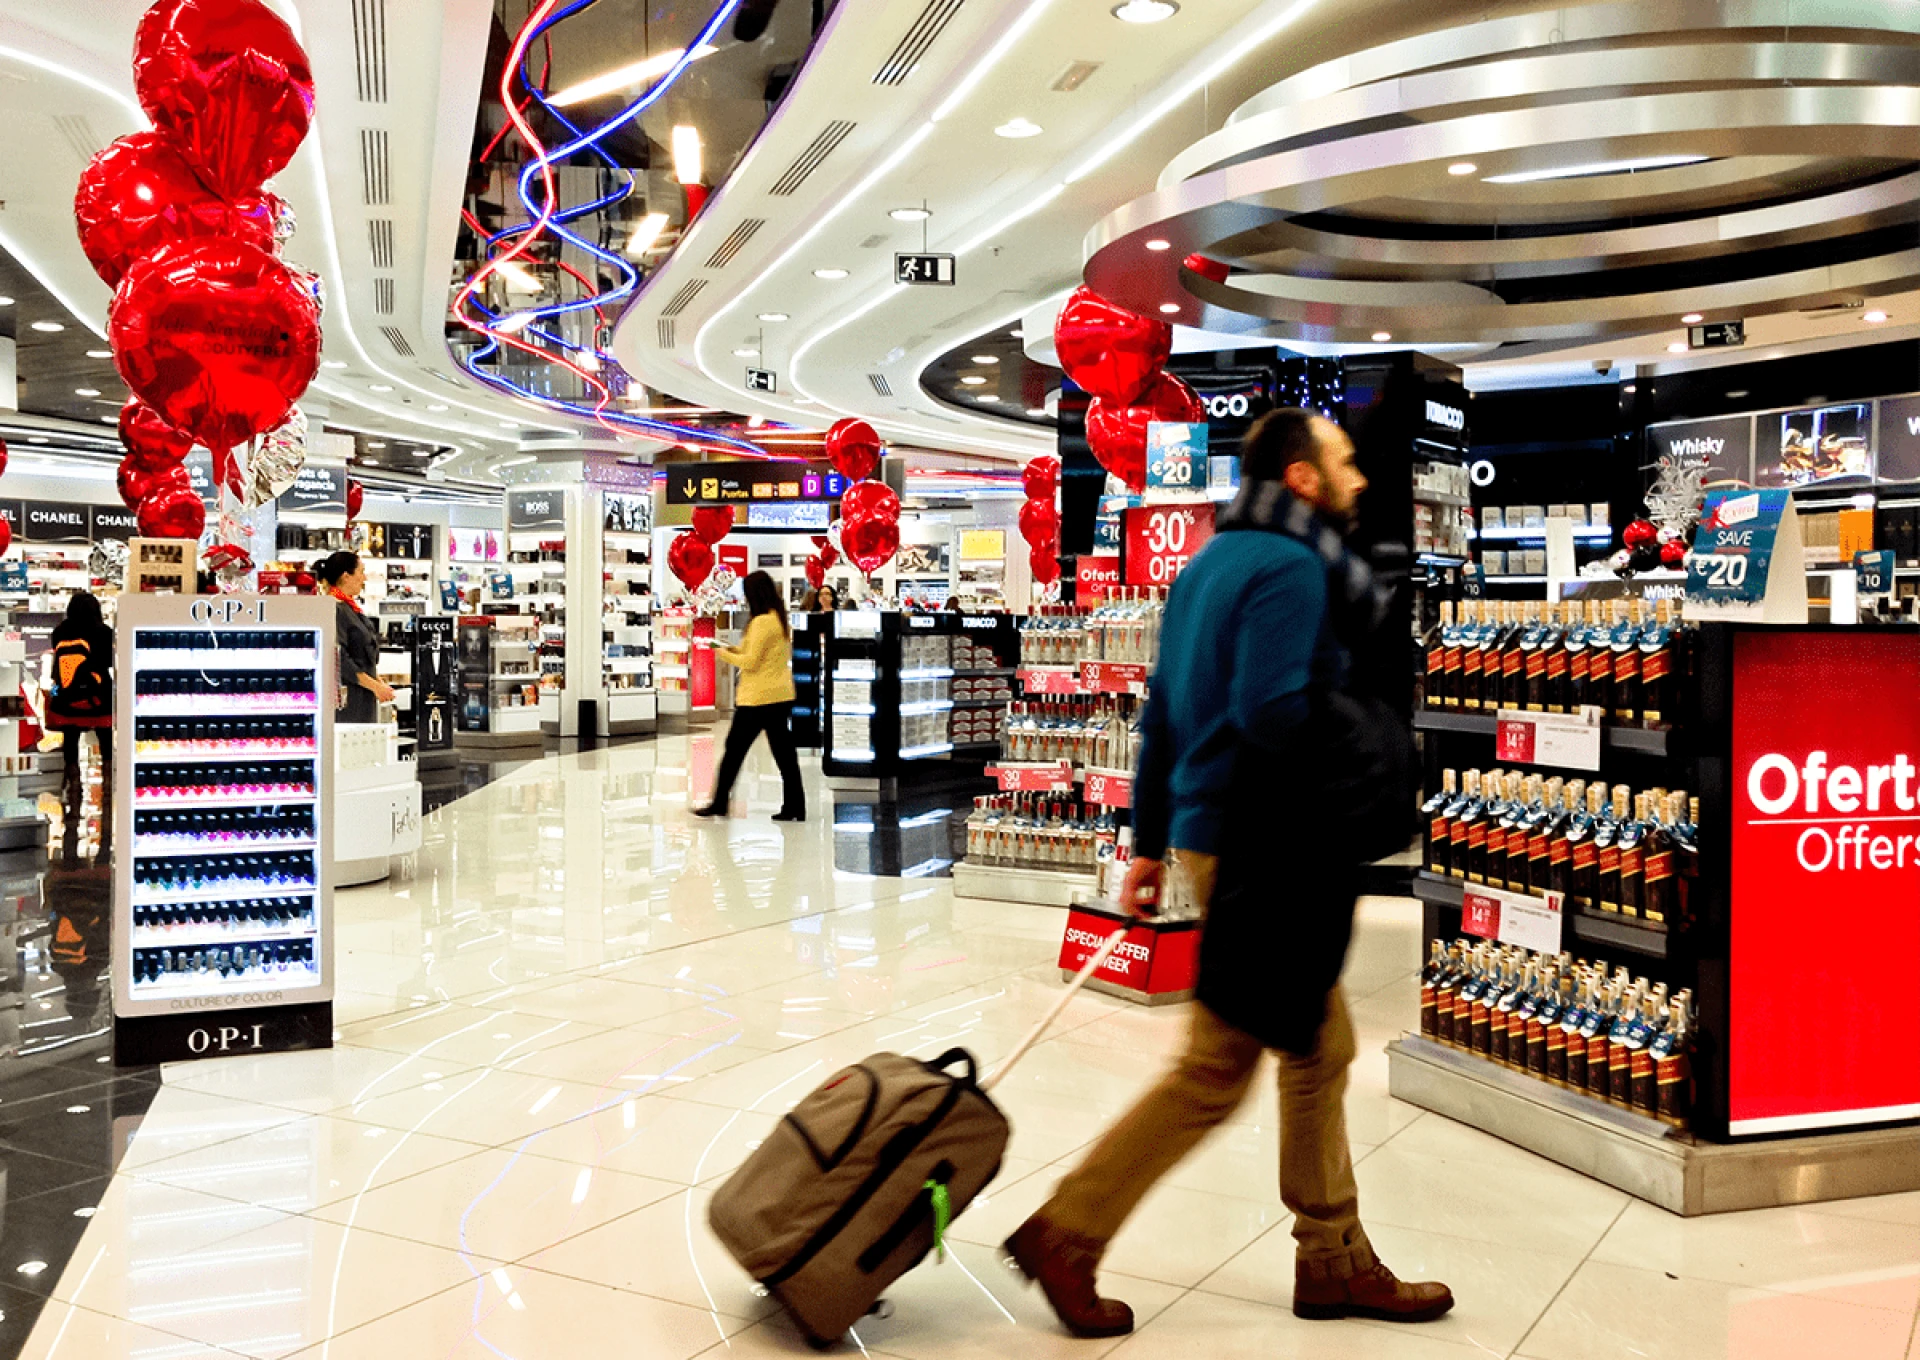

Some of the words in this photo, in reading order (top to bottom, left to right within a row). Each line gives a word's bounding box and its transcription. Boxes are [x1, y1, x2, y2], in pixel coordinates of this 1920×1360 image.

[1164, 447, 1190, 457] SAVE
[1669, 437, 1725, 456] Whisky
[1151, 461, 1192, 484] €20
[807, 479, 817, 494] D
[829, 478, 839, 493] E
[30, 511, 84, 525] CHANEL
[96, 514, 139, 528] CHANE
[1716, 530, 1754, 546] SAVE
[1081, 568, 1120, 581] Ofert
[1644, 584, 1686, 600] Whisk
[422, 622, 450, 631] GUCCI
[1747, 750, 1920, 815] Ofert
[1066, 928, 1106, 950] SPECIA
[1112, 940, 1150, 962] OFFER
[170, 996, 221, 1009] CULTURE
[225, 994, 238, 1005] OF
[242, 991, 283, 1004] COLOR
